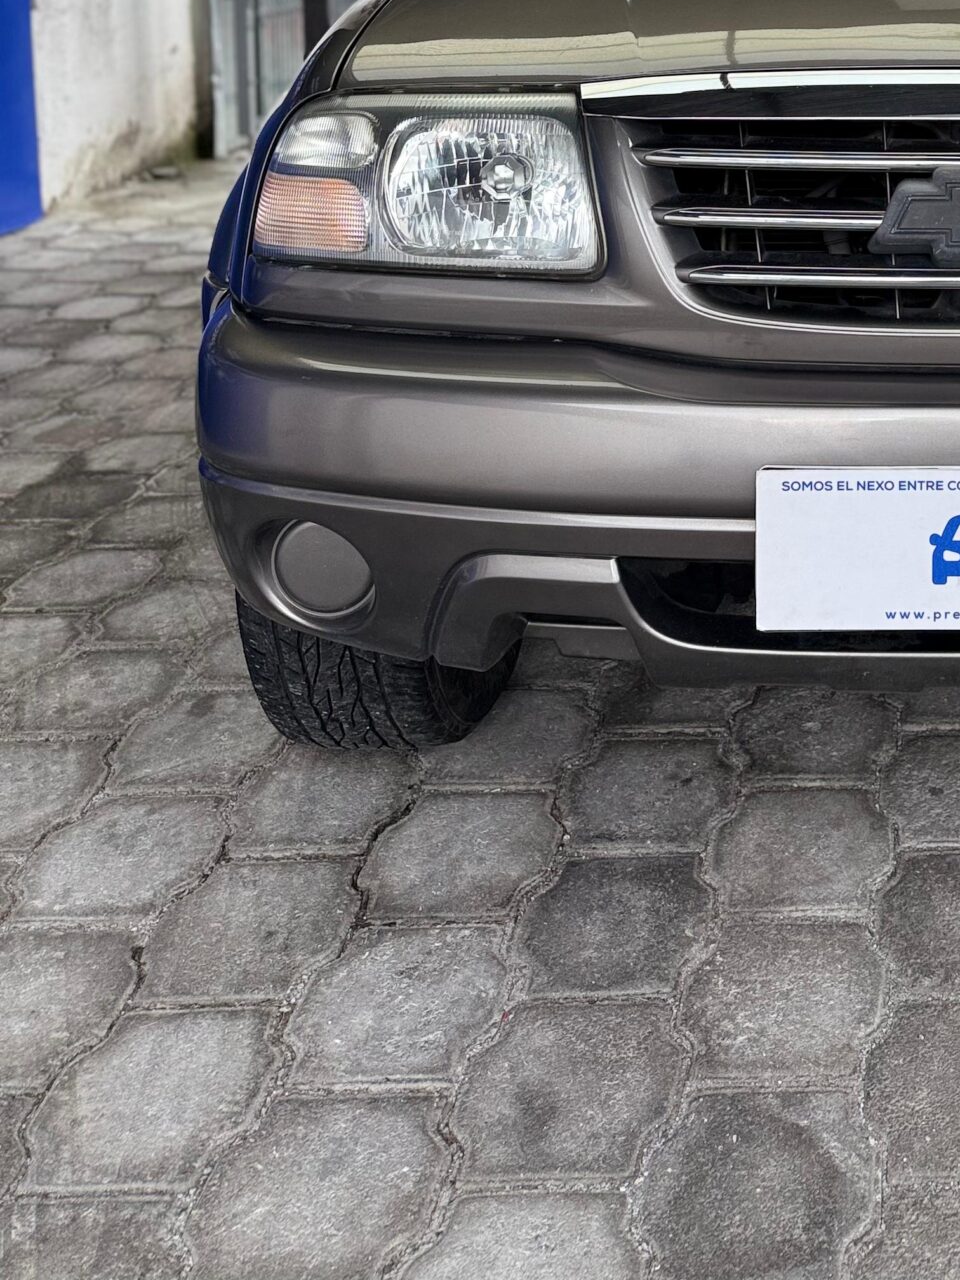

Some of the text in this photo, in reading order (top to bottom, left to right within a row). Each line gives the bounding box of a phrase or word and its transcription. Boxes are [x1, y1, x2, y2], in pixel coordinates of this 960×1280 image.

[781, 480, 834, 492] SOMOS
[836, 480, 854, 492] EL
[856, 480, 895, 492] NEXO
[898, 480, 944, 491] ENTRE
